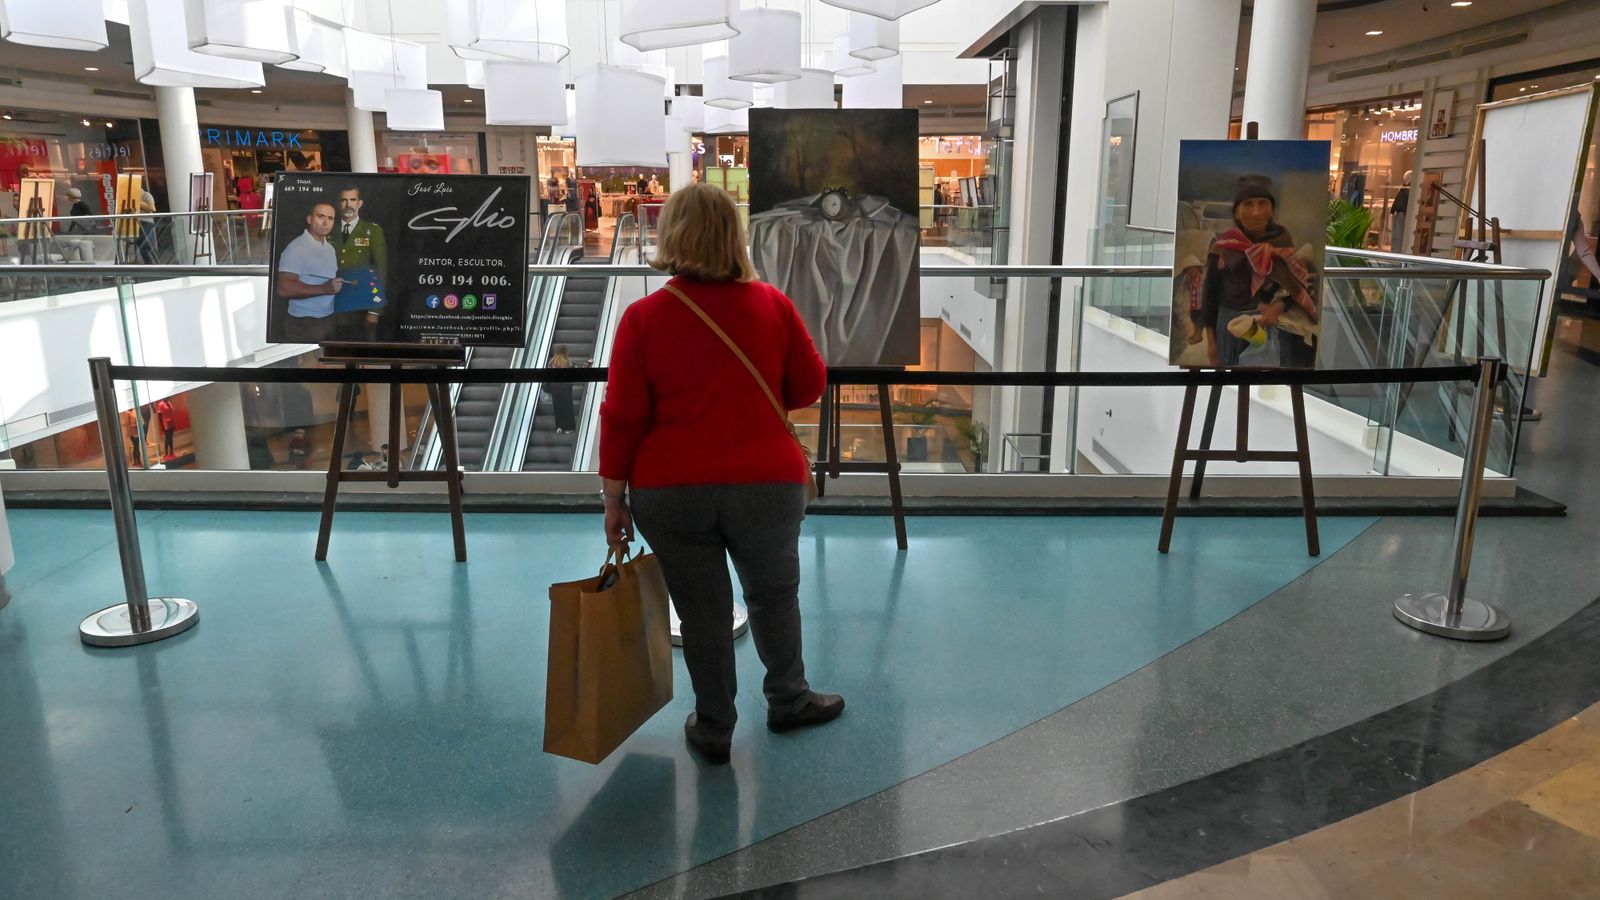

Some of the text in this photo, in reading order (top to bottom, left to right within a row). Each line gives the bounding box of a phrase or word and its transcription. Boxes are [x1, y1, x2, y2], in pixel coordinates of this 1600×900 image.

[199, 127, 303, 149] RIMARK
[1380, 129, 1419, 142] HOMBRE
[408, 182, 454, 196] José Luis
[418, 273, 512, 287] 669 194 006.
